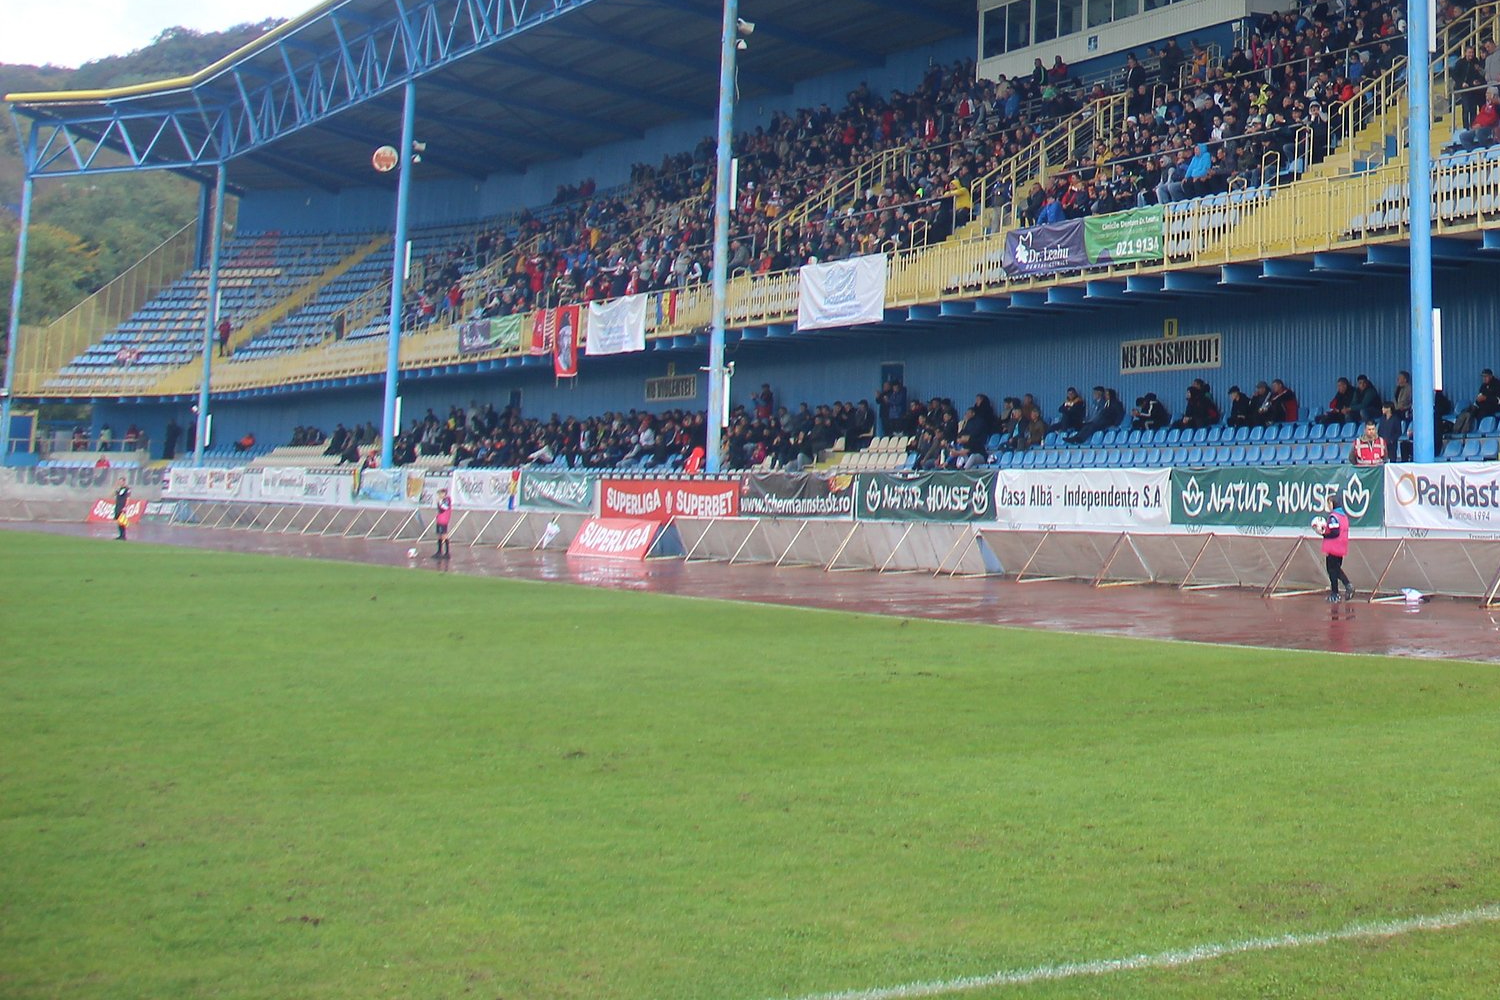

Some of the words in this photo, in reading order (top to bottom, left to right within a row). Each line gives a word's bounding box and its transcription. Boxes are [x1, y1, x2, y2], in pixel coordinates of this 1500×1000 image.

[1028, 248, 1042, 264] Dr.
[1043, 244, 1069, 262] Leahu
[1116, 239, 1134, 256] 021
[1122, 345, 1137, 369] NU
[1140, 339, 1212, 368] RASISMULUI
[606, 487, 662, 515] SUPERLIGA
[676, 489, 733, 517] SUPERBET
[927, 484, 971, 513] HOUSE
[1001, 485, 1026, 507] Casa
[1029, 484, 1053, 507] Albă
[1206, 480, 1272, 513] NATUR
[1276, 481, 1340, 514] HOUSE
[1417, 474, 1499, 519] Palplast
[1473, 511, 1490, 522] 1994
[579, 521, 652, 552] SUPERLIGA
